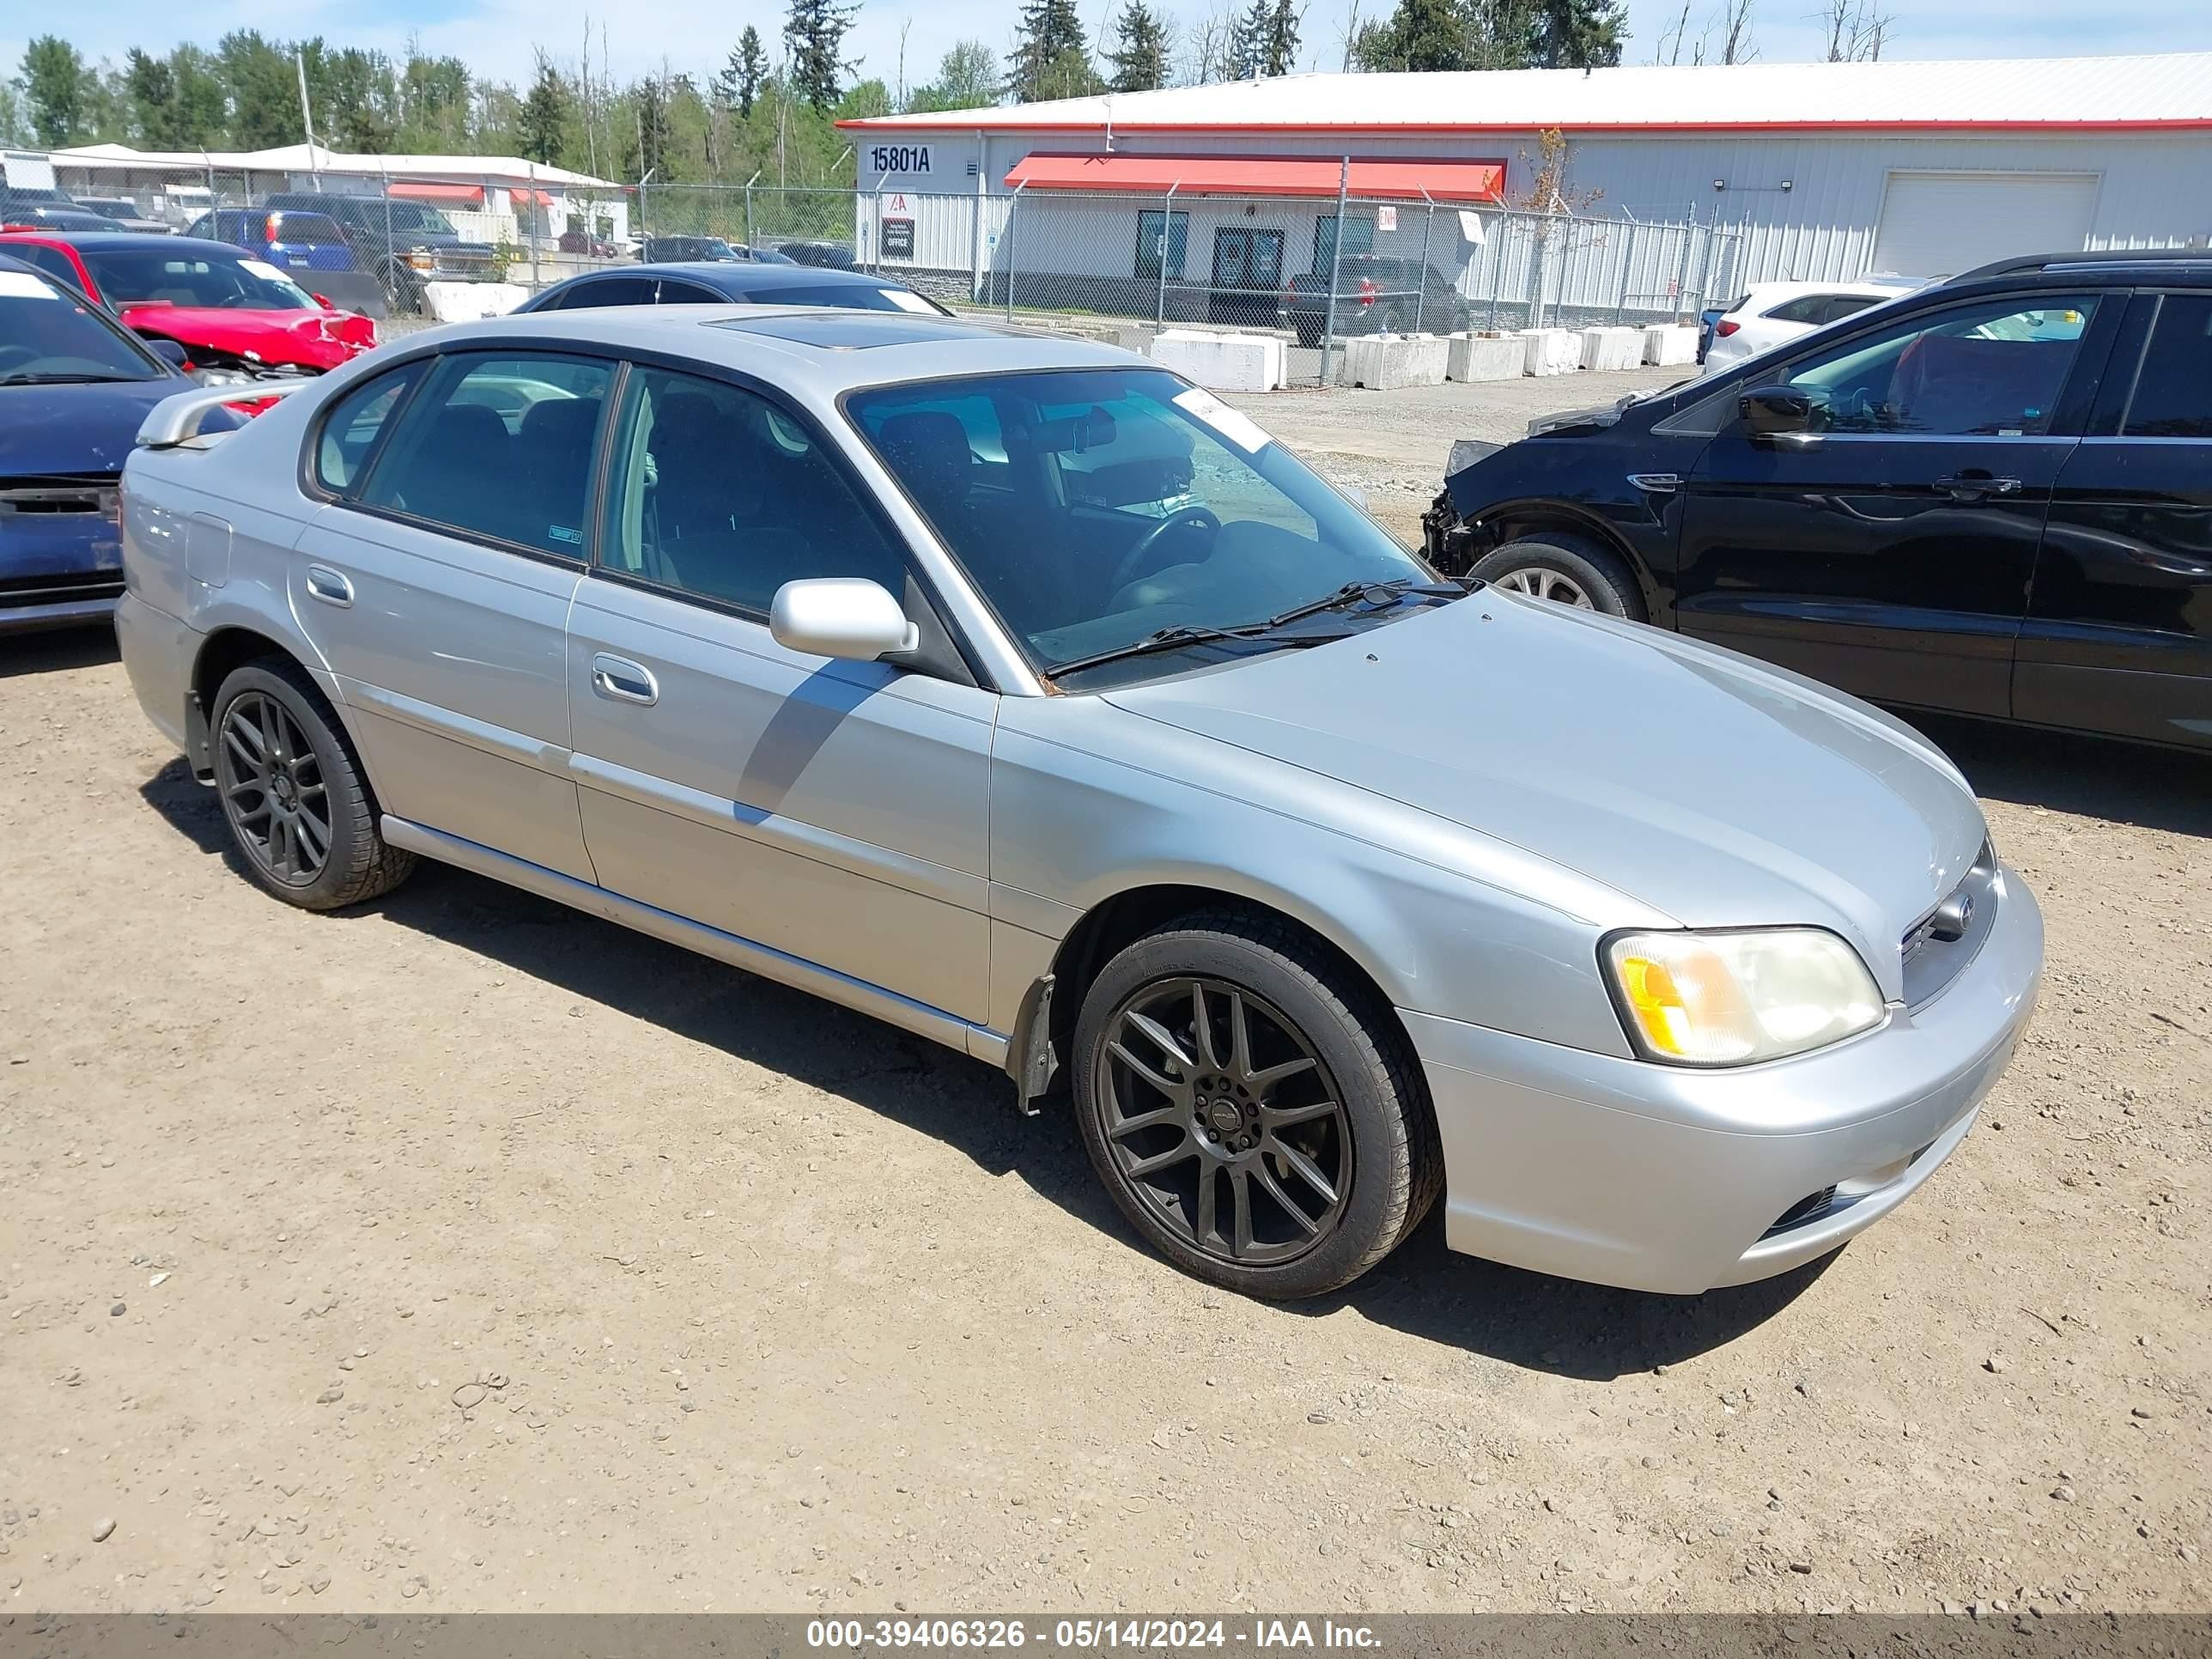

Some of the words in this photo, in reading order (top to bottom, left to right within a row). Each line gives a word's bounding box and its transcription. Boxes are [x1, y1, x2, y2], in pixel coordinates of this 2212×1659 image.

[871, 147, 930, 172] 15801A
[1380, 210, 1395, 225] ENH
[888, 238, 908, 247] OFFICE
